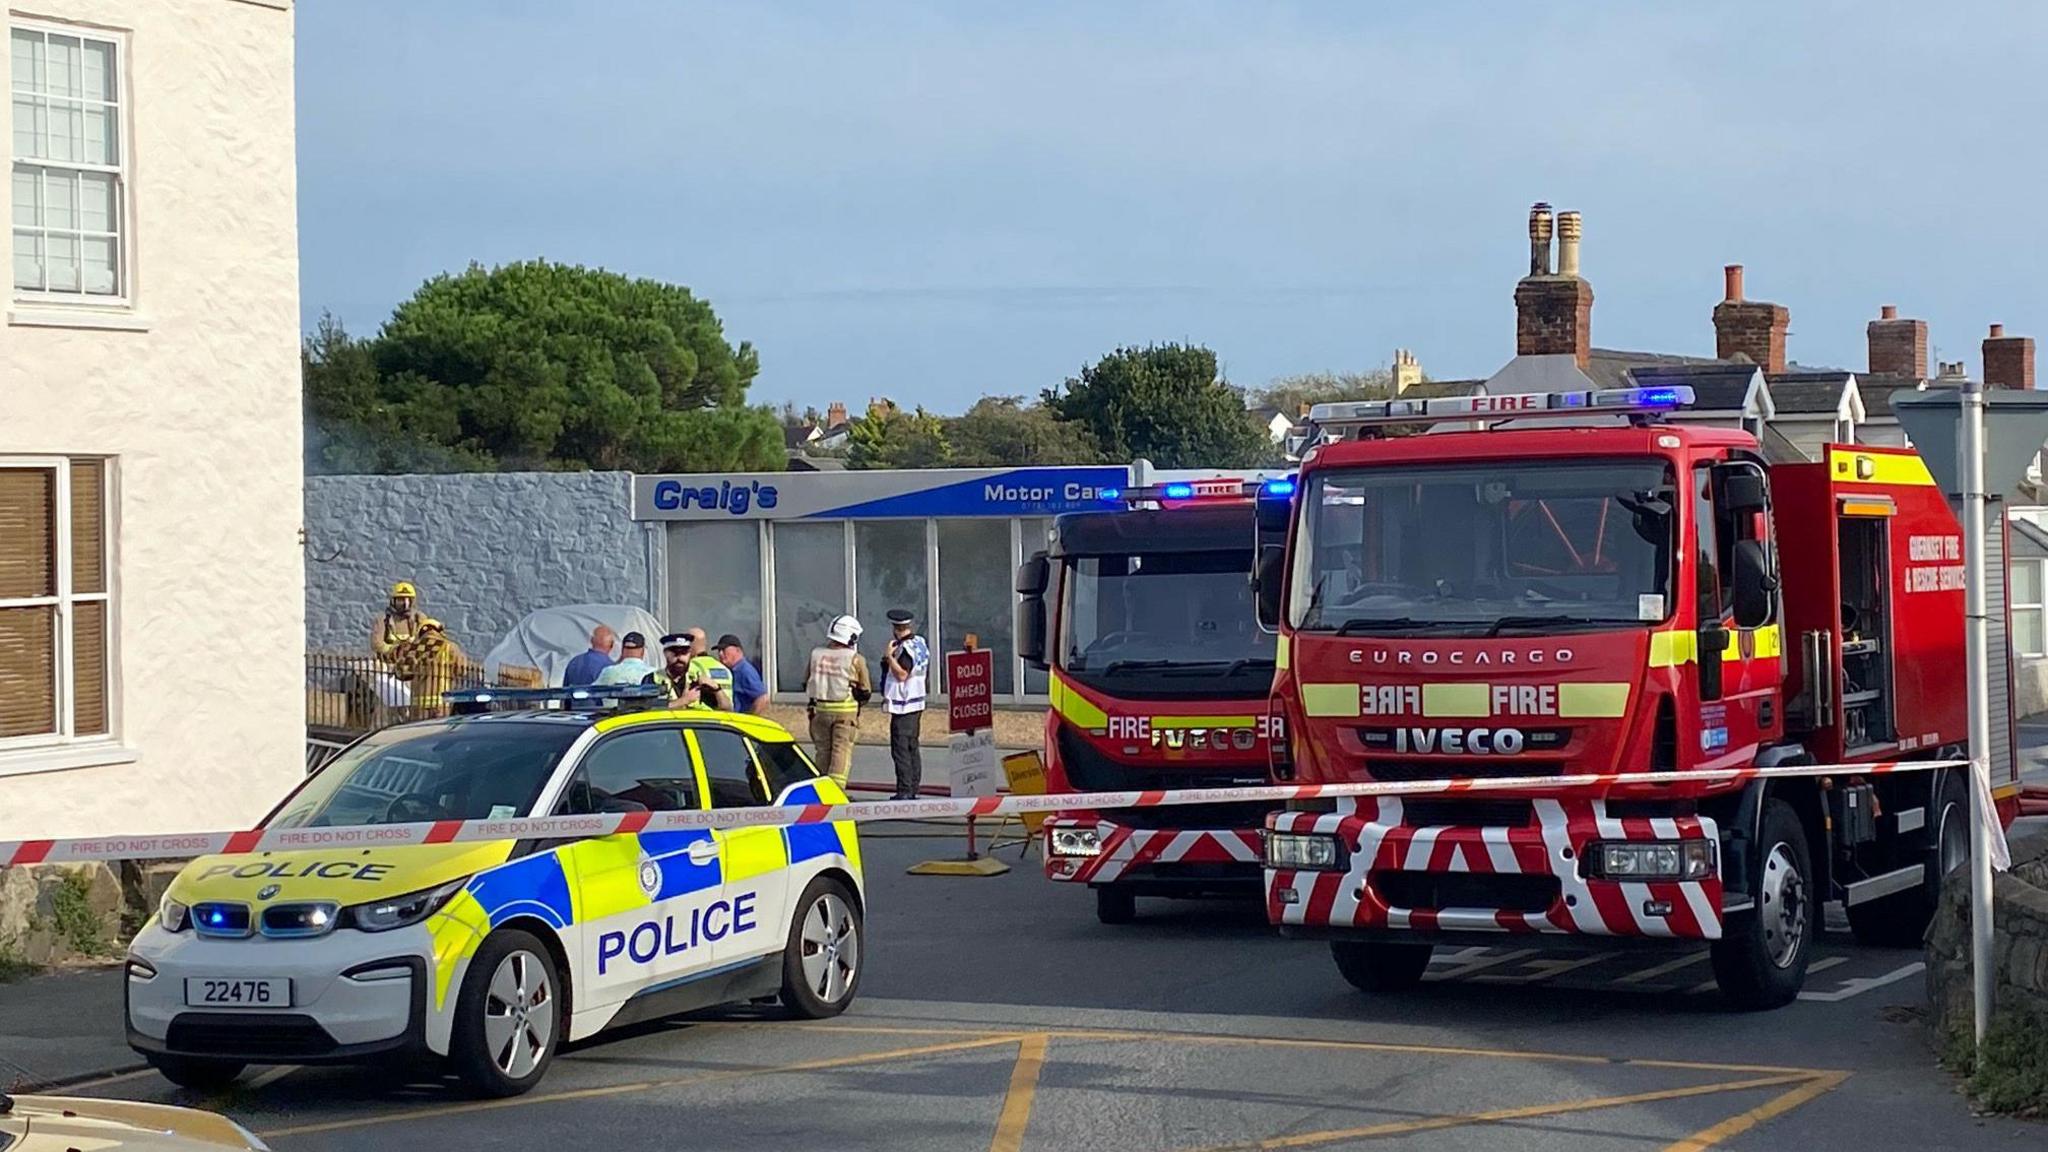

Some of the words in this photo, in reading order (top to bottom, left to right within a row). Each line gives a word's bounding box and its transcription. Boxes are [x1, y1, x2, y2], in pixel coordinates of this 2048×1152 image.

[1472, 396, 1537, 411] FIRE
[655, 480, 778, 515] Craig's
[985, 484, 1053, 501] Motor
[1198, 486, 1236, 494] FIRE
[1350, 650, 1573, 664] EUROCARGO
[957, 664, 984, 679] ROAD
[955, 683, 986, 699] AHEAD
[1492, 685, 1556, 715] FIRE
[953, 703, 989, 718] CLOSED
[1109, 716, 1150, 738] FIRE
[1151, 727, 1255, 750] IVECO
[1396, 727, 1523, 754] IVECO
[846, 806, 869, 816] FIRE
[874, 804, 891, 815] DO
[894, 803, 918, 814] NOT
[920, 802, 959, 812] CROSS
[1016, 798, 1041, 808] FIRE
[1062, 795, 1084, 805] NOT
[667, 815, 692, 825] FIRE
[696, 813, 714, 823] DO
[717, 811, 740, 822] NOT
[744, 810, 785, 820] CROSS
[478, 823, 506, 834] FIRE
[510, 822, 528, 832] DO
[531, 820, 557, 831] NOT
[561, 819, 602, 829] CROSS
[280, 833, 309, 844] FIRE
[313, 831, 332, 842] DO
[336, 830, 362, 841] NOT
[366, 828, 412, 840] CROSS
[71, 842, 101, 854] FIRE
[106, 840, 126, 852] DO
[129, 839, 158, 851] NOT
[161, 837, 209, 850] CROSS
[197, 861, 395, 881] POLICE
[598, 891, 757, 976] POLICE
[204, 981, 270, 1002] 22476
